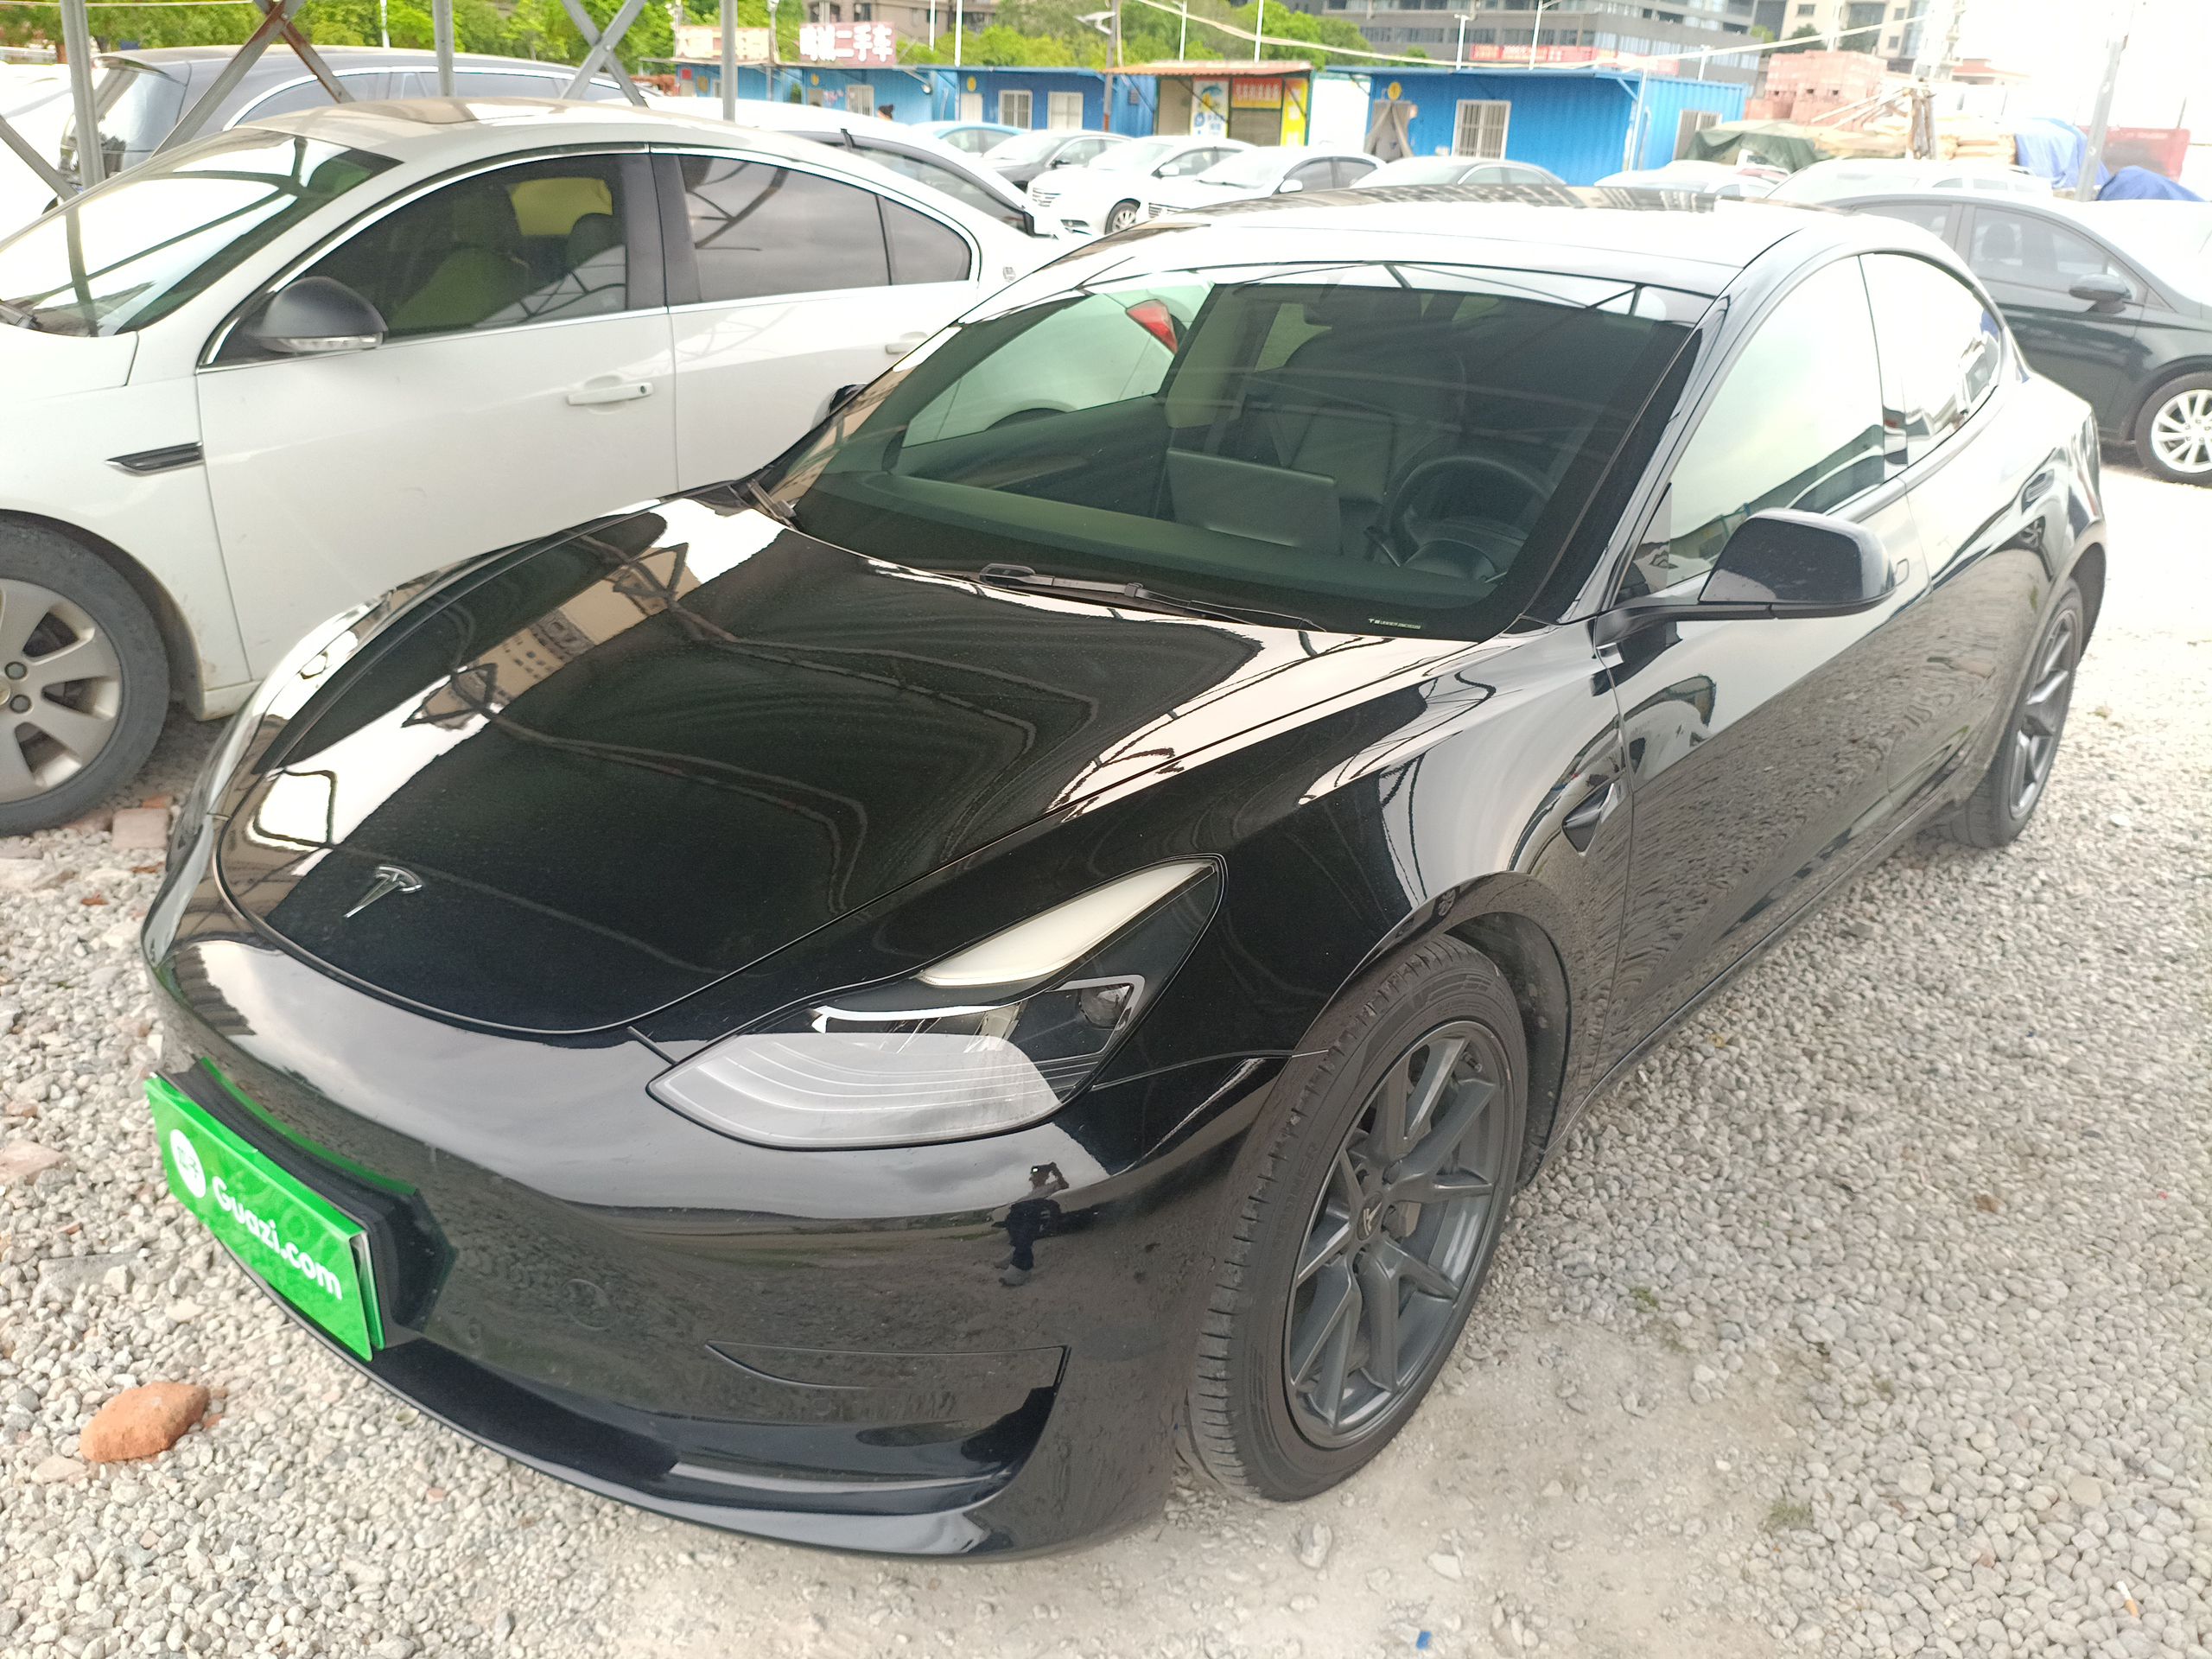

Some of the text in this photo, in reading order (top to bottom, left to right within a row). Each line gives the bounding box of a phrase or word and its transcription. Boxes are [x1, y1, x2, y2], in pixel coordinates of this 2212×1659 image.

[799, 24, 893, 62] 二手车
[212, 1175, 342, 1300] Guazi.com
